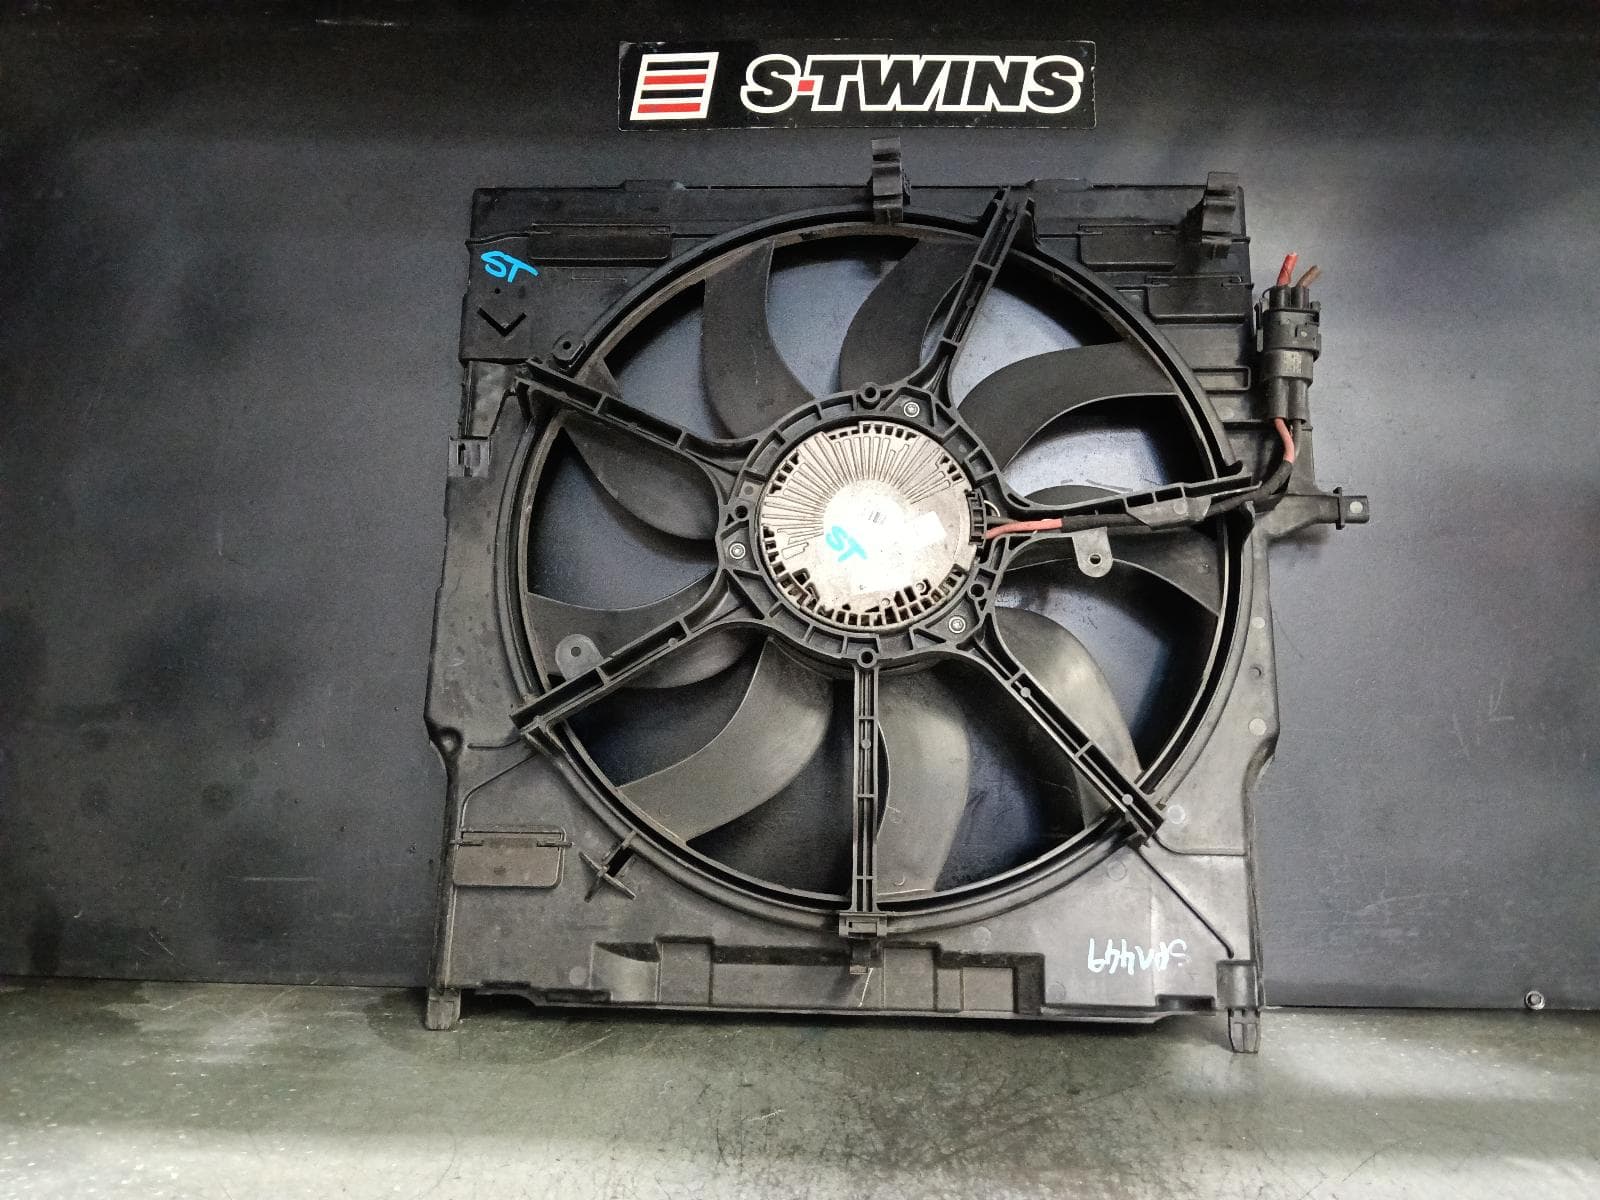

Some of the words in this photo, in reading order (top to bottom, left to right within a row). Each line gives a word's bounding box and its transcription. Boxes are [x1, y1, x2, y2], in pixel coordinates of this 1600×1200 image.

[740, 54, 1084, 114] S-TWINS
[481, 250, 539, 283] ST
[825, 525, 868, 563] ST
